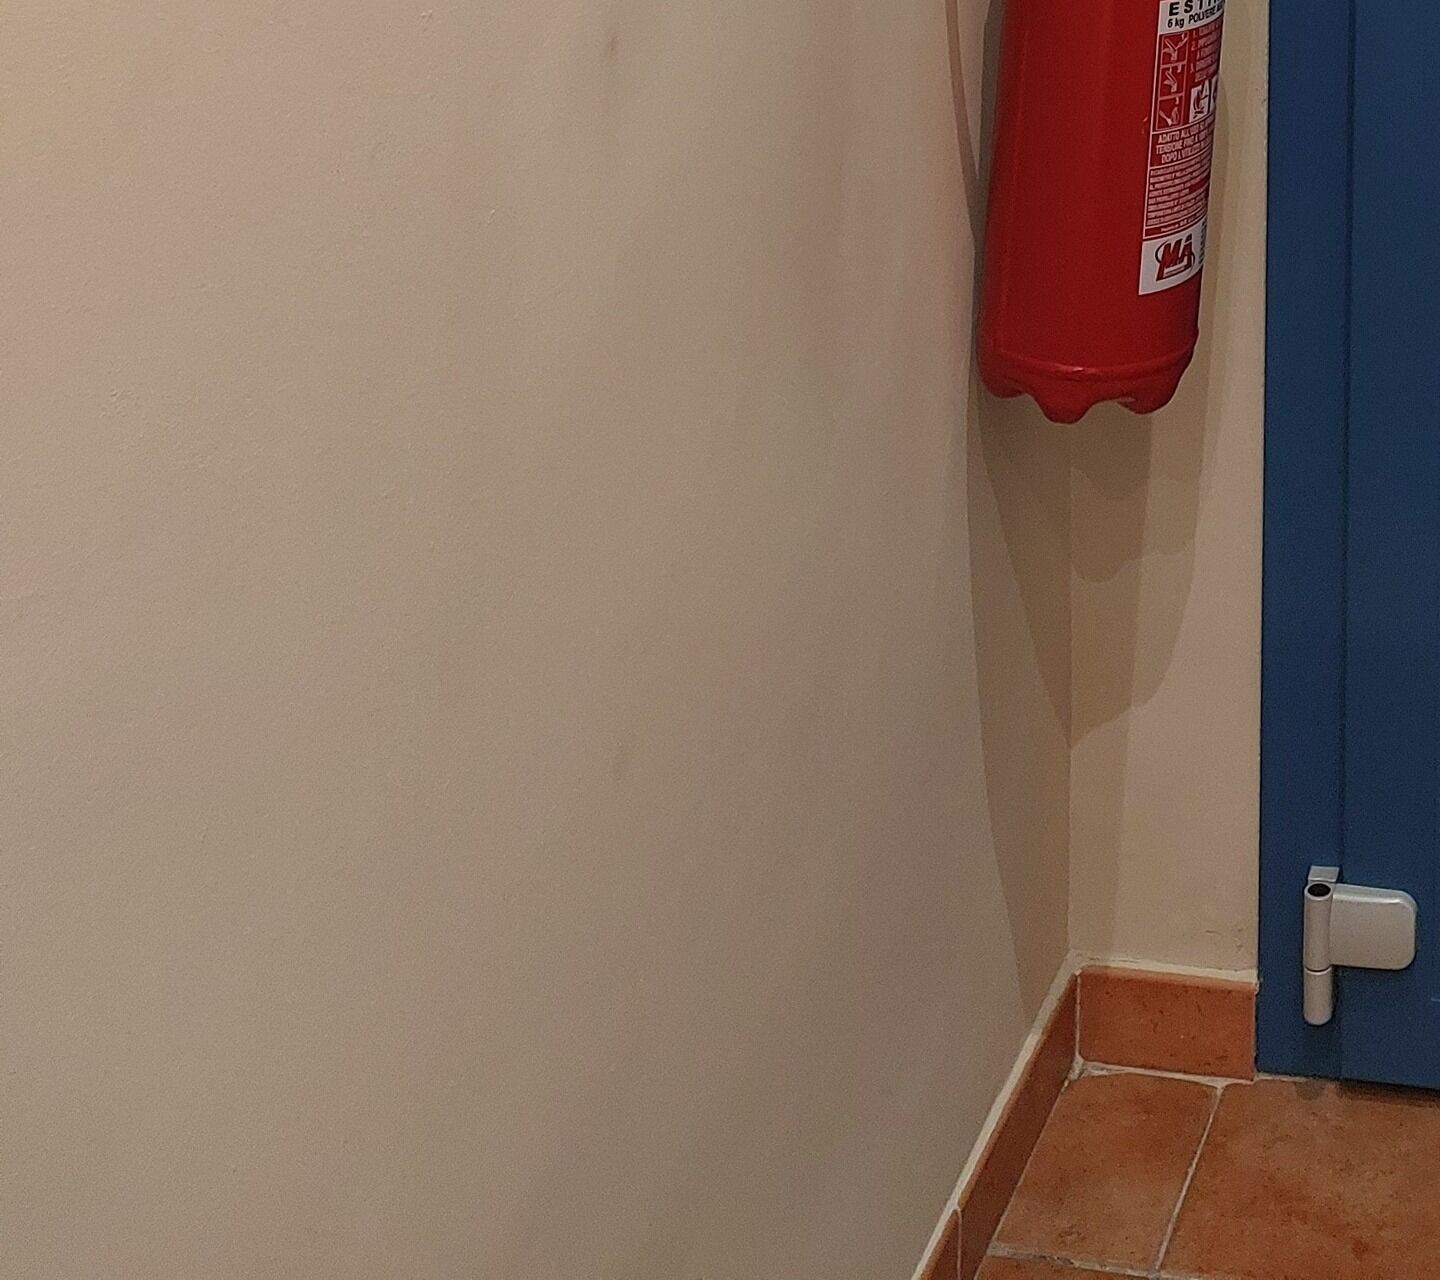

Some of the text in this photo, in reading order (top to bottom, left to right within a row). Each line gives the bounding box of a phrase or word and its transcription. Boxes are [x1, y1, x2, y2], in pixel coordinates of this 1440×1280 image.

[1167, 18, 1173, 28] 6
[1174, 17, 1185, 28] kg
[1188, 4, 1216, 25] POLVERE
